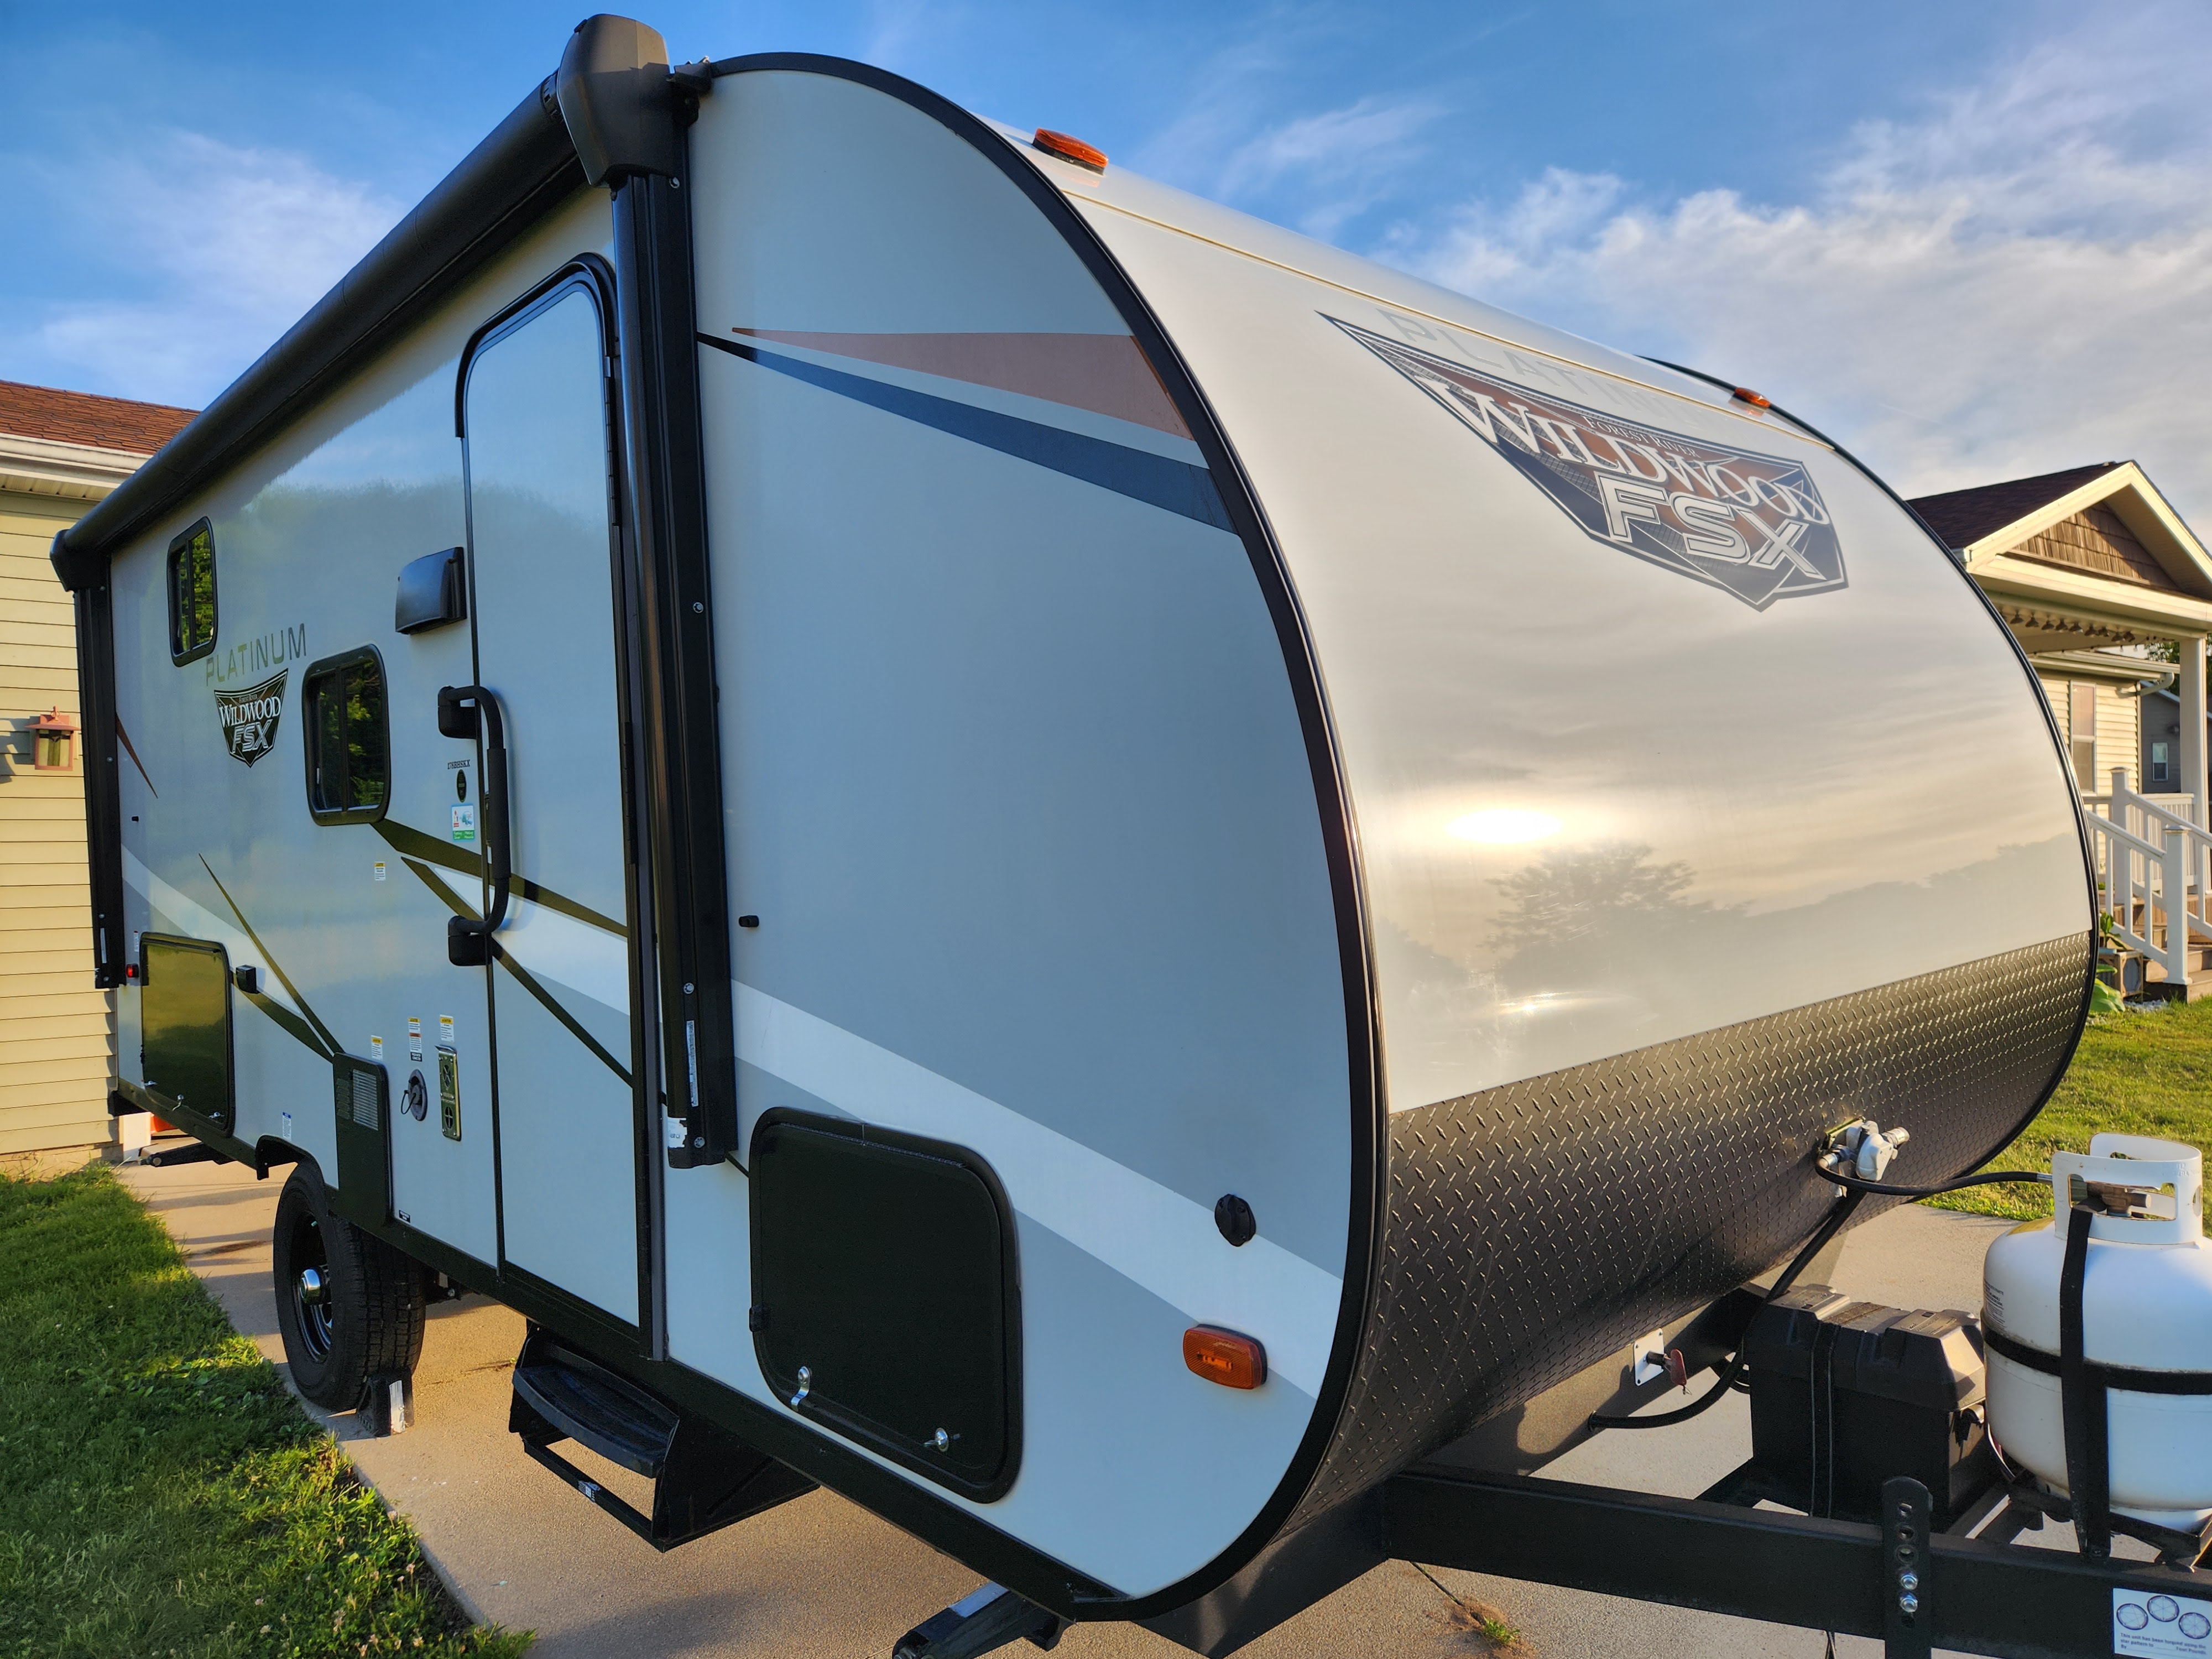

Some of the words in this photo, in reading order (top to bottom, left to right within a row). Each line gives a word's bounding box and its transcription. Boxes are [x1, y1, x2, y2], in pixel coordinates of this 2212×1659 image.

[1415, 376, 1832, 525] WILDWOOD
[1580, 415, 1650, 444] FOREST
[1650, 435, 1702, 458] RIVER
[1595, 471, 1827, 581] FSX
[206, 623, 306, 686] PLATINUM
[219, 696, 281, 728] WILDWOOD
[232, 719, 273, 753] FSX
